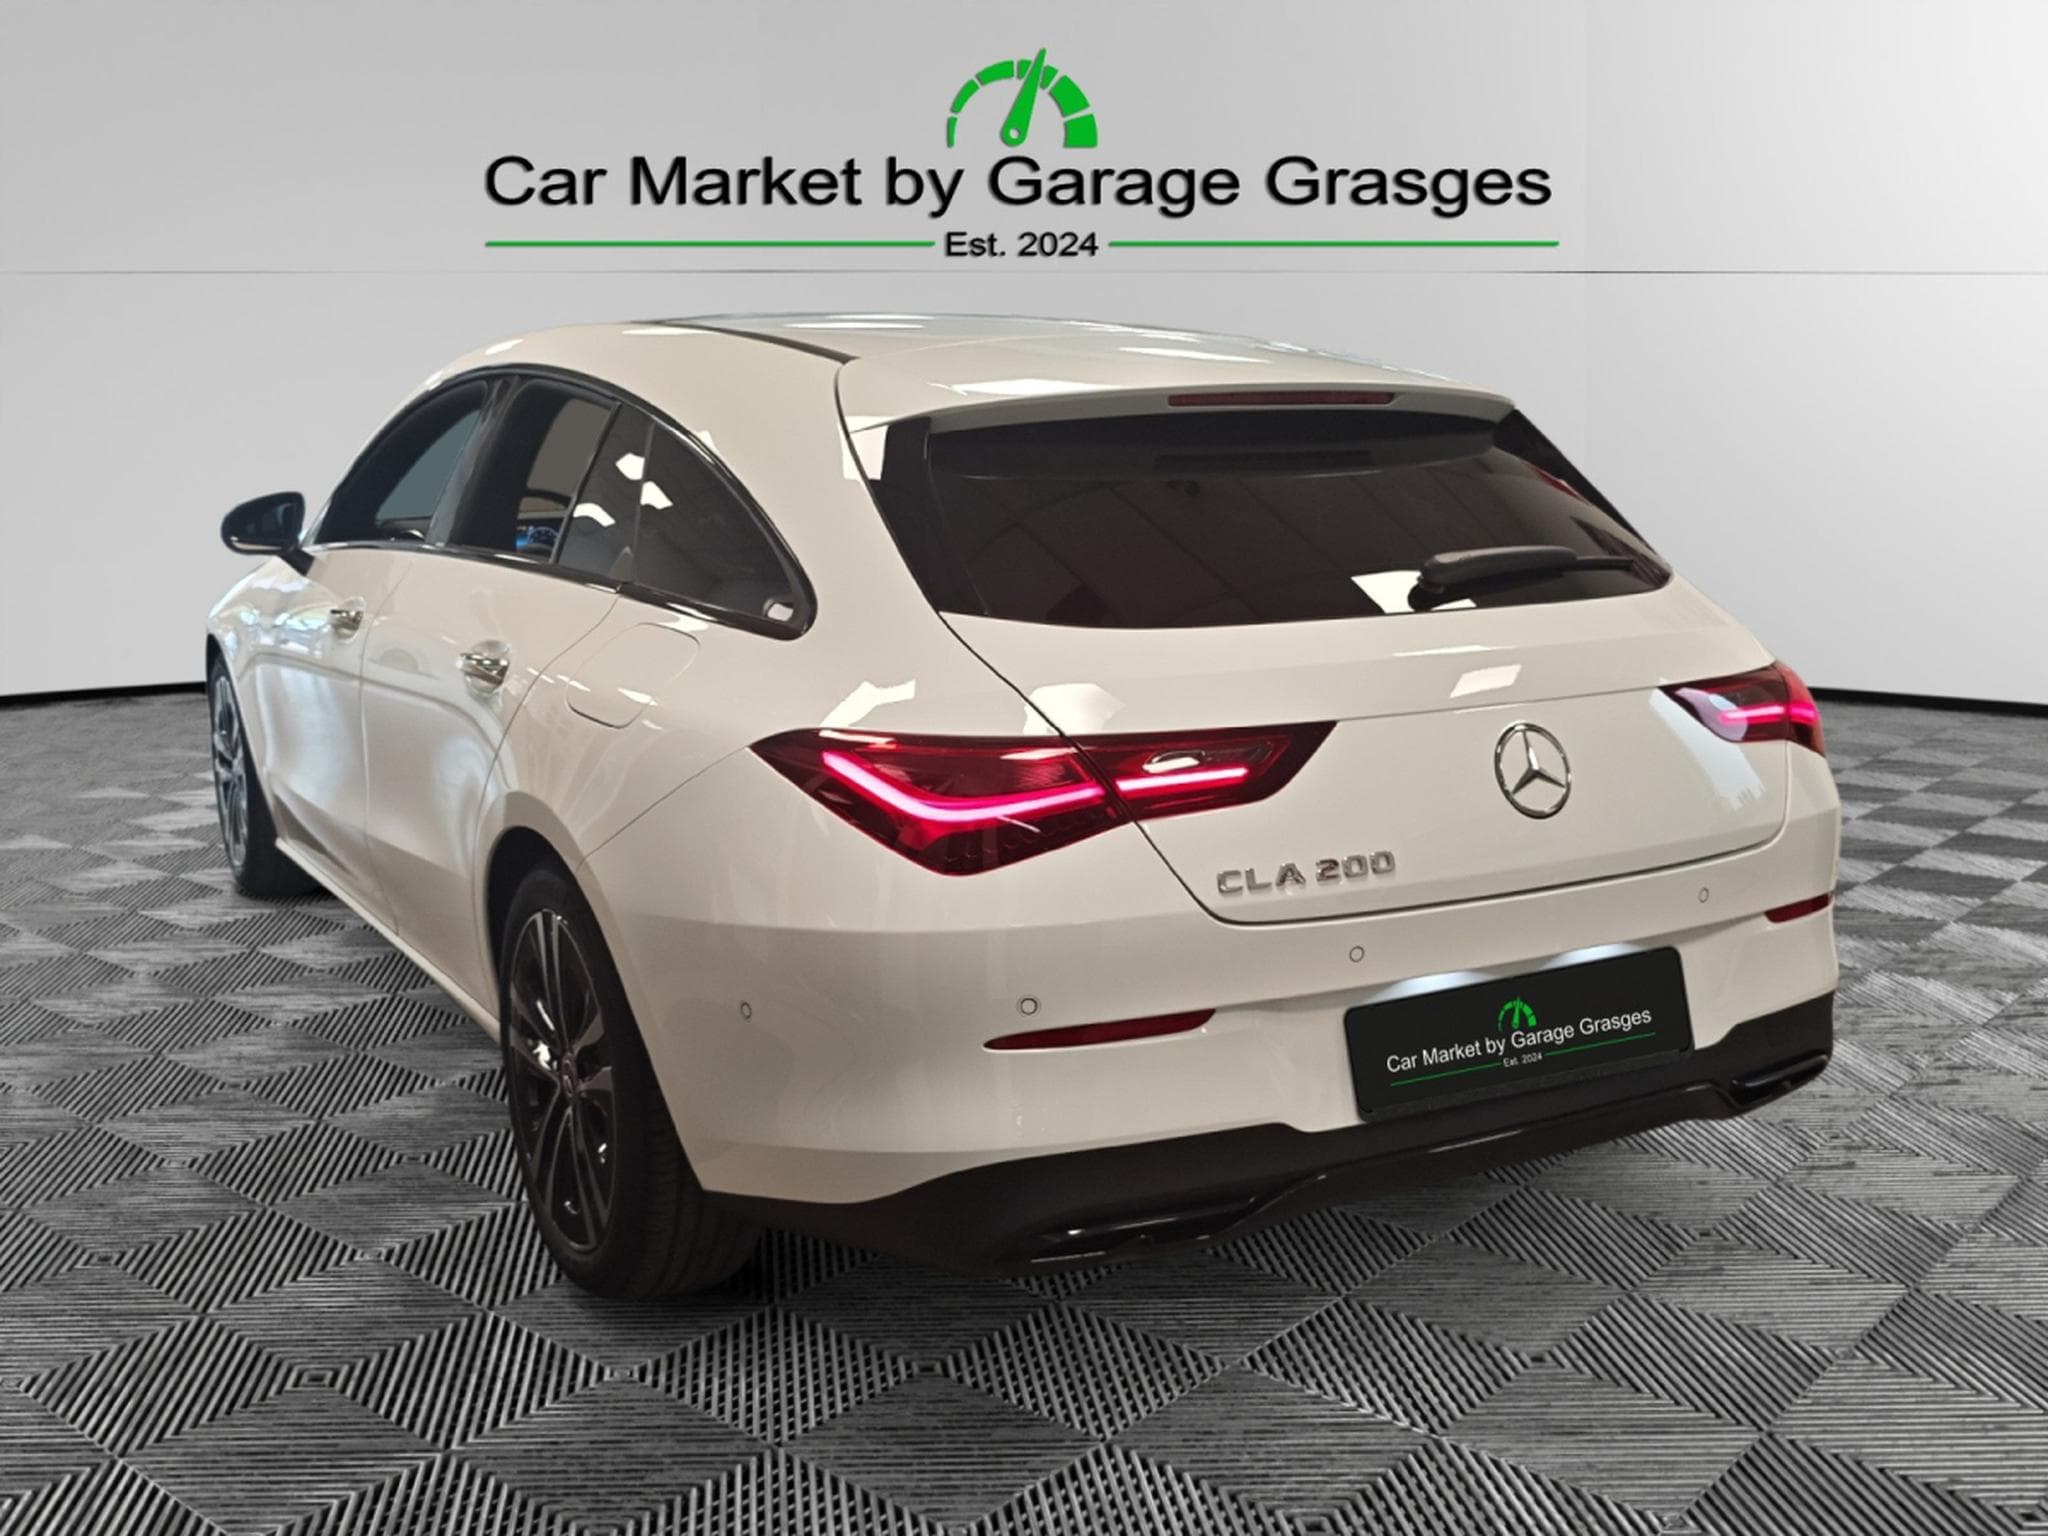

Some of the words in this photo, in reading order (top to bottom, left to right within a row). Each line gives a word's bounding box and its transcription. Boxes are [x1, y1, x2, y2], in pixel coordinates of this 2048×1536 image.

[1217, 862, 1306, 894] CLA
[1315, 850, 1396, 882] 200
[1386, 1054, 1417, 1073] Car
[1422, 1040, 1481, 1066] Market
[1485, 1037, 1506, 1056] by
[1511, 1024, 1575, 1048] Garage
[1579, 1009, 1652, 1035] Grasges
[1521, 1052, 1543, 1065] 2024
